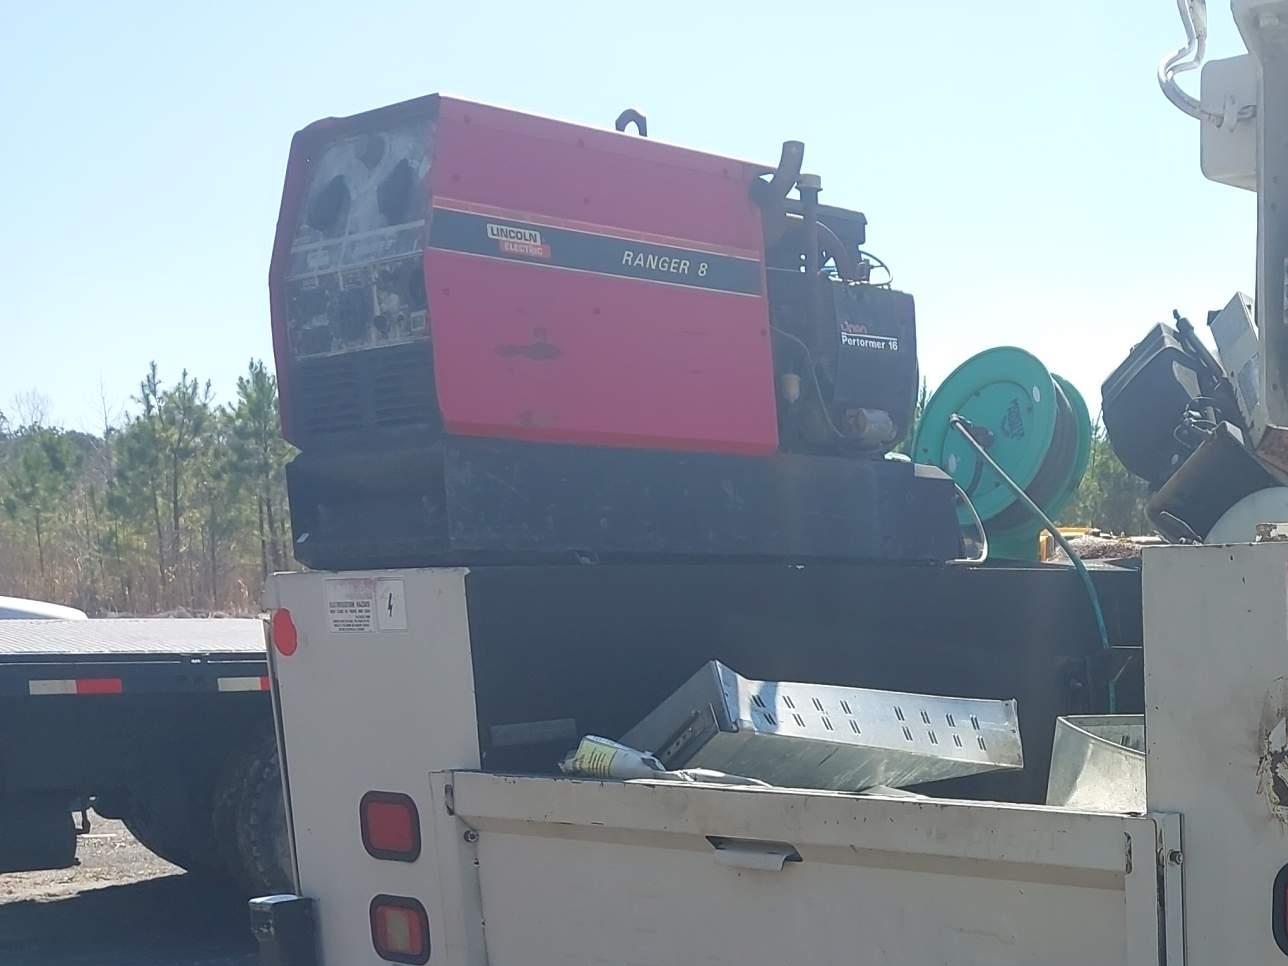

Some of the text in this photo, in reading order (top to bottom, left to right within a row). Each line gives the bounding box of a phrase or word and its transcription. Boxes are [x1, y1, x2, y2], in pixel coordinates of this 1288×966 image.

[490, 226, 538, 243] LINCOLN
[504, 242, 544, 256] ELECTRIC
[621, 250, 708, 277] RANGER 8
[888, 340, 898, 351] 16
